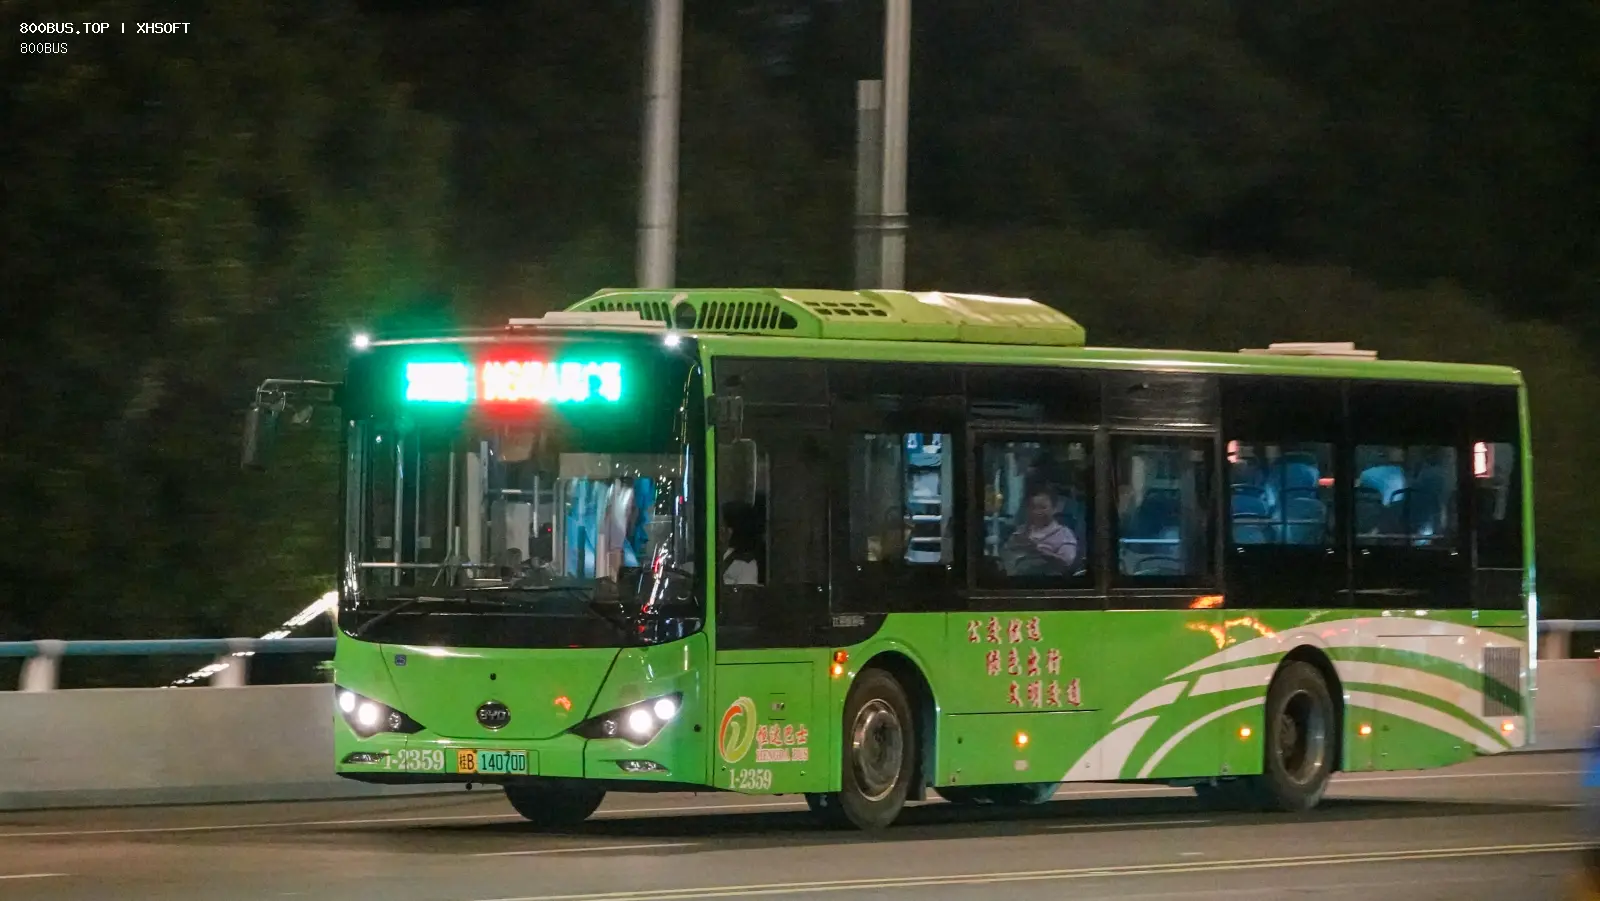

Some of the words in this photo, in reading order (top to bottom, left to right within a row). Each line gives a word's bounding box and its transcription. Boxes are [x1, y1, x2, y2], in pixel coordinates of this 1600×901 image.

[480, 709, 506, 720] BYD
[382, 749, 445, 770] 1-2359
[481, 753, 526, 772] 14070D
[729, 768, 772, 790] 1-2359
